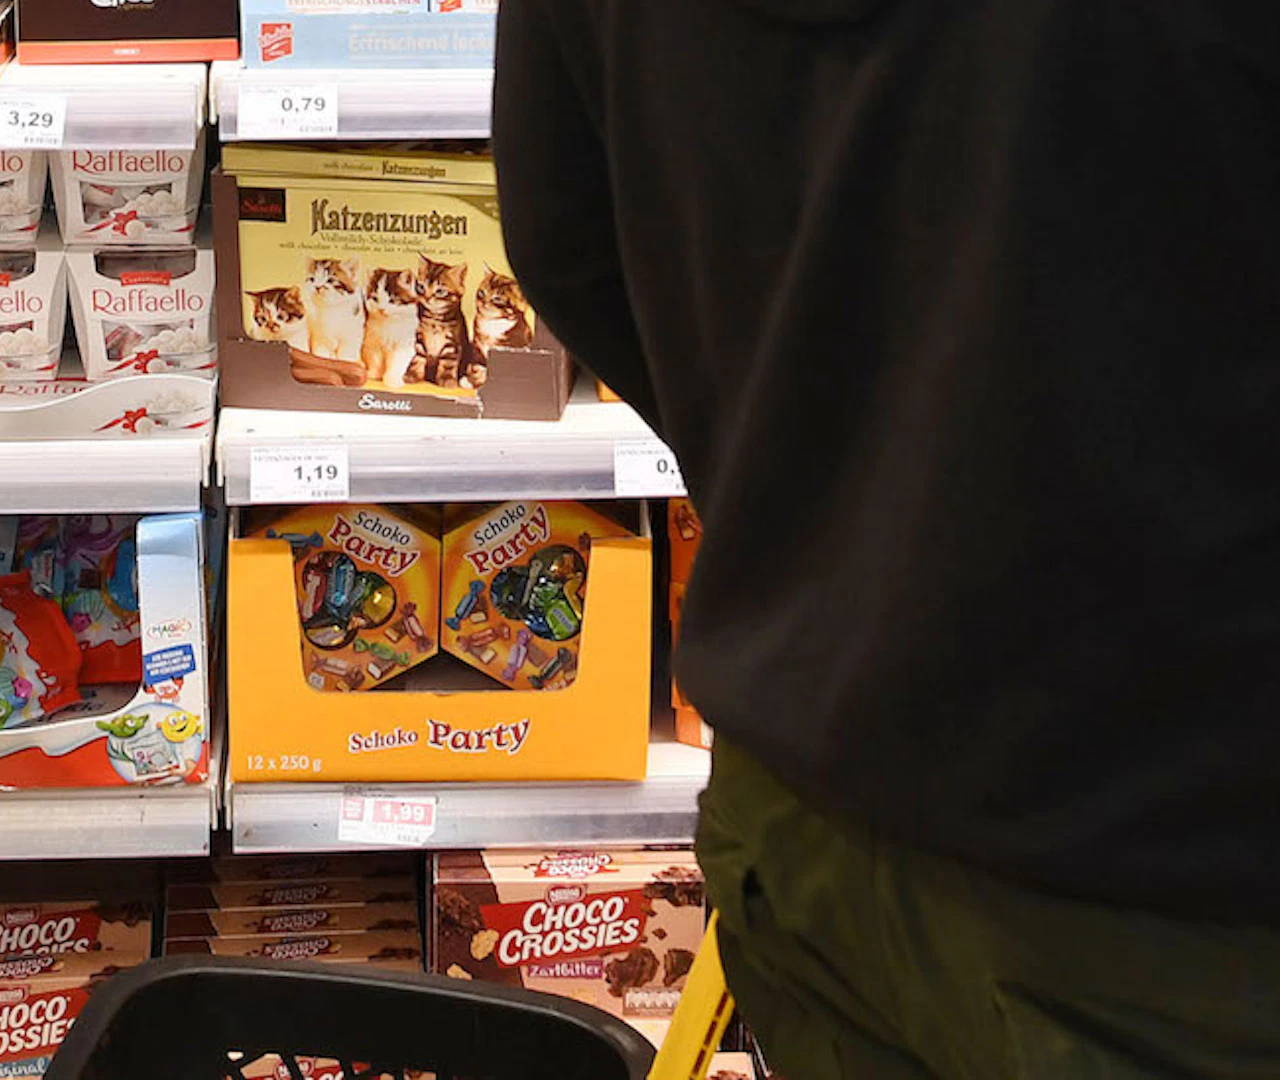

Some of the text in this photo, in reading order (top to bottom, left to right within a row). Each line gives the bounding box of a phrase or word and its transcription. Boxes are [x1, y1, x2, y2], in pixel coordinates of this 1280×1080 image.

[280, 95, 327, 114] 0,79
[7, 111, 54, 129] 3,29
[381, 160, 447, 179] Katzenzungen
[310, 198, 468, 240] Katzenzungen
[91, 288, 204, 314] Raffaello
[357, 393, 413, 412] Sarotti
[293, 464, 338, 483] 1,19
[352, 510, 411, 546] Schoko
[473, 502, 527, 546] Schoko
[327, 516, 420, 577] Party
[465, 506, 552, 576] Party
[348, 719, 531, 755] Schoko Party
[245, 754, 323, 772] 12 250 g
[378, 803, 425, 822] 1,99
[523, 897, 625, 936] CHOCO
[497, 917, 643, 966] CROSSIES
[528, 961, 603, 979] Zartbitter
